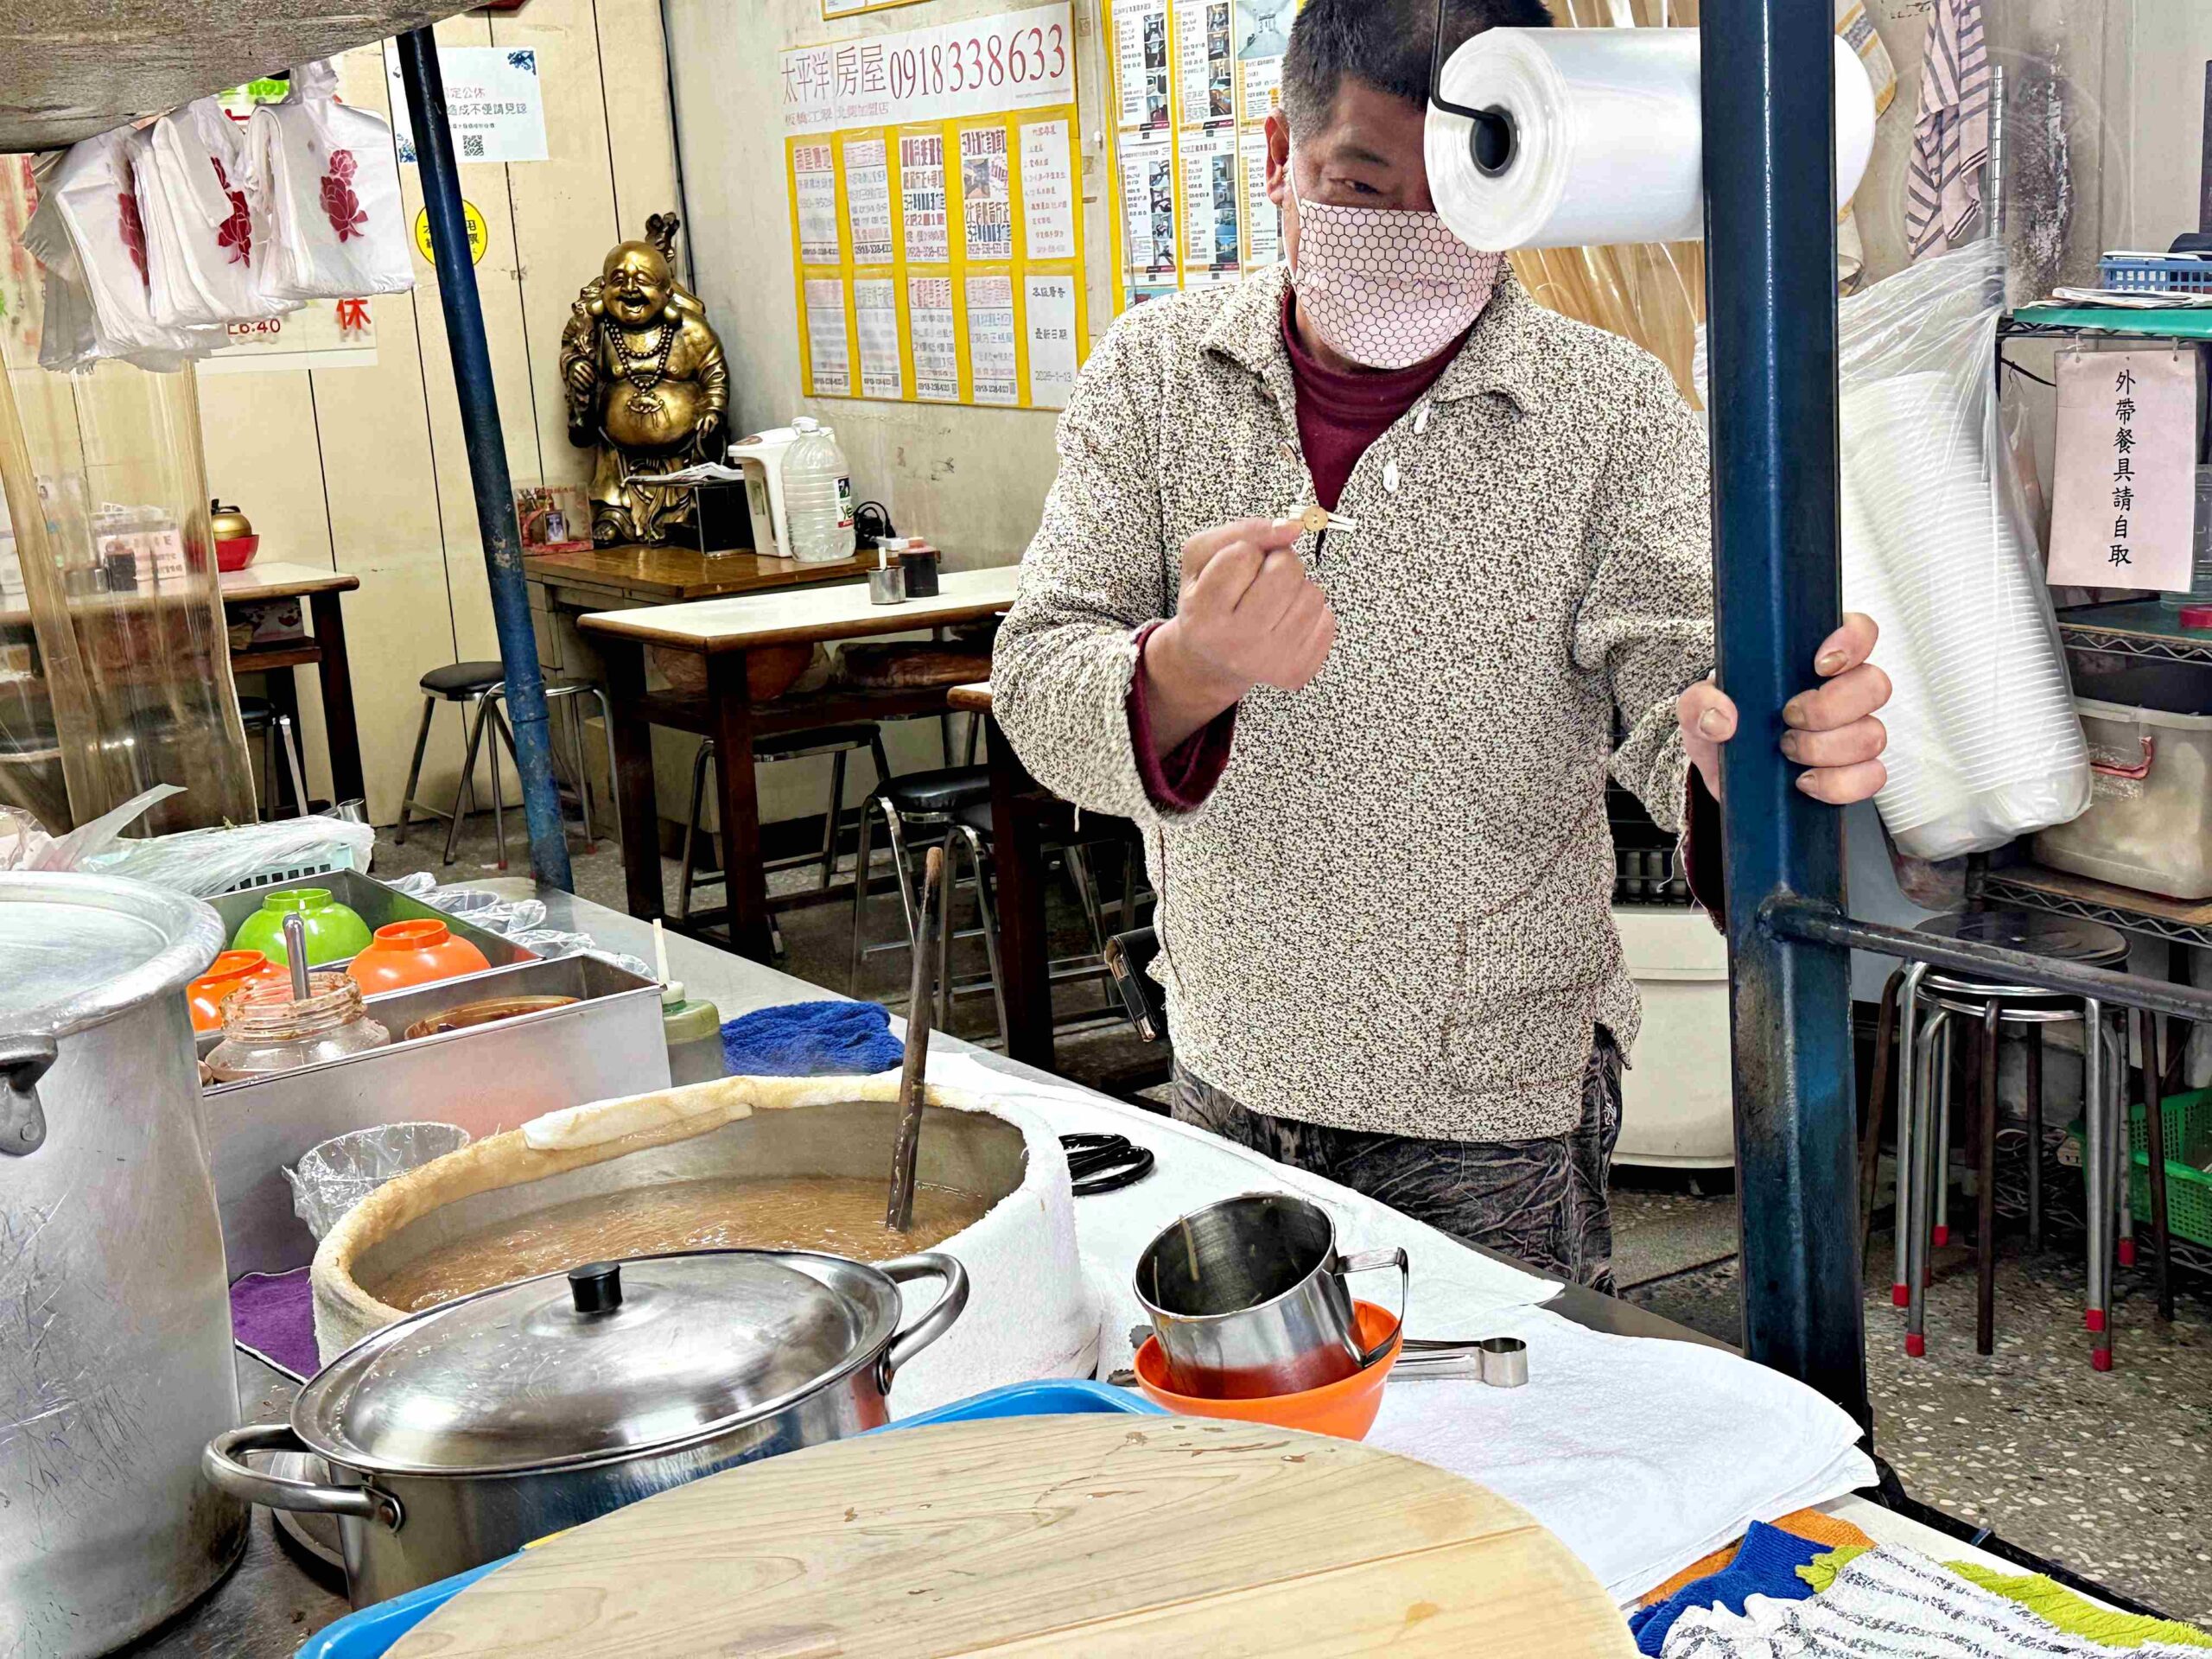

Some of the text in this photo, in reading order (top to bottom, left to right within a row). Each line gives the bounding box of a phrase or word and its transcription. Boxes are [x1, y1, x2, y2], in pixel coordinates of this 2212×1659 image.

[781, 44, 887, 104] 太平洋房屋
[889, 23, 1065, 99] 0918338633
[2107, 369, 2137, 568] 外帶餐具請自取
